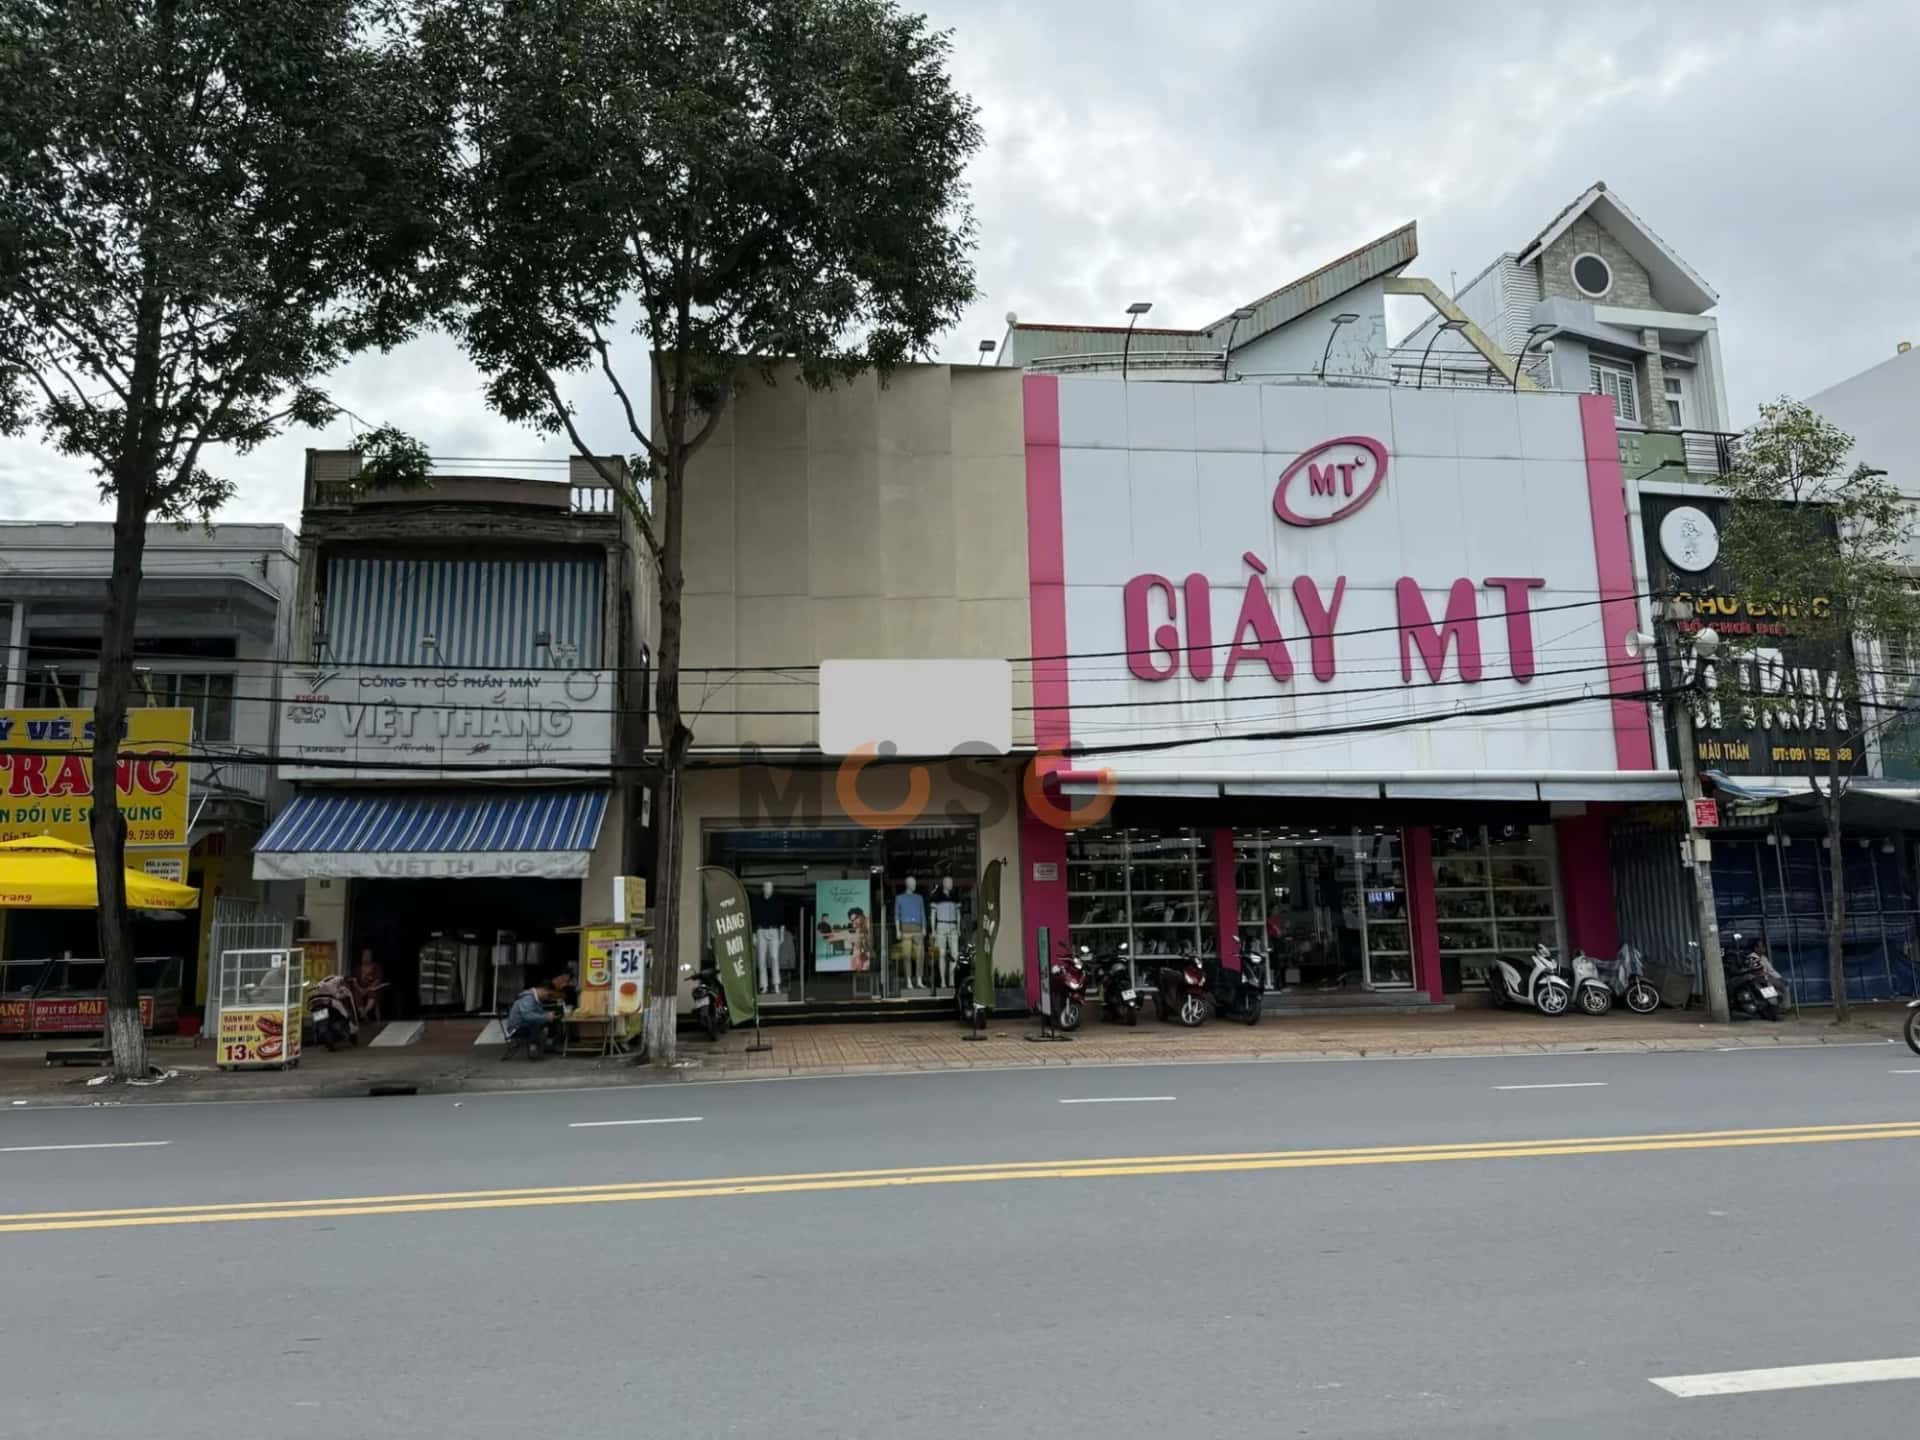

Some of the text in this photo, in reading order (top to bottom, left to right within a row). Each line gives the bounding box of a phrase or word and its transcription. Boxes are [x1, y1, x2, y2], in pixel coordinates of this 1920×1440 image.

[1308, 463, 1357, 497] MT
[1124, 551, 1546, 684] GIÀY MT
[359, 674, 406, 688] CÔNG
[413, 676, 427, 688] TY
[434, 672, 459, 688] CỔ
[509, 676, 541, 688] MAY
[27, 715, 71, 740] VÉ
[336, 689, 573, 745] VIỆT THẮNG
[118, 806, 162, 822] RÚNG
